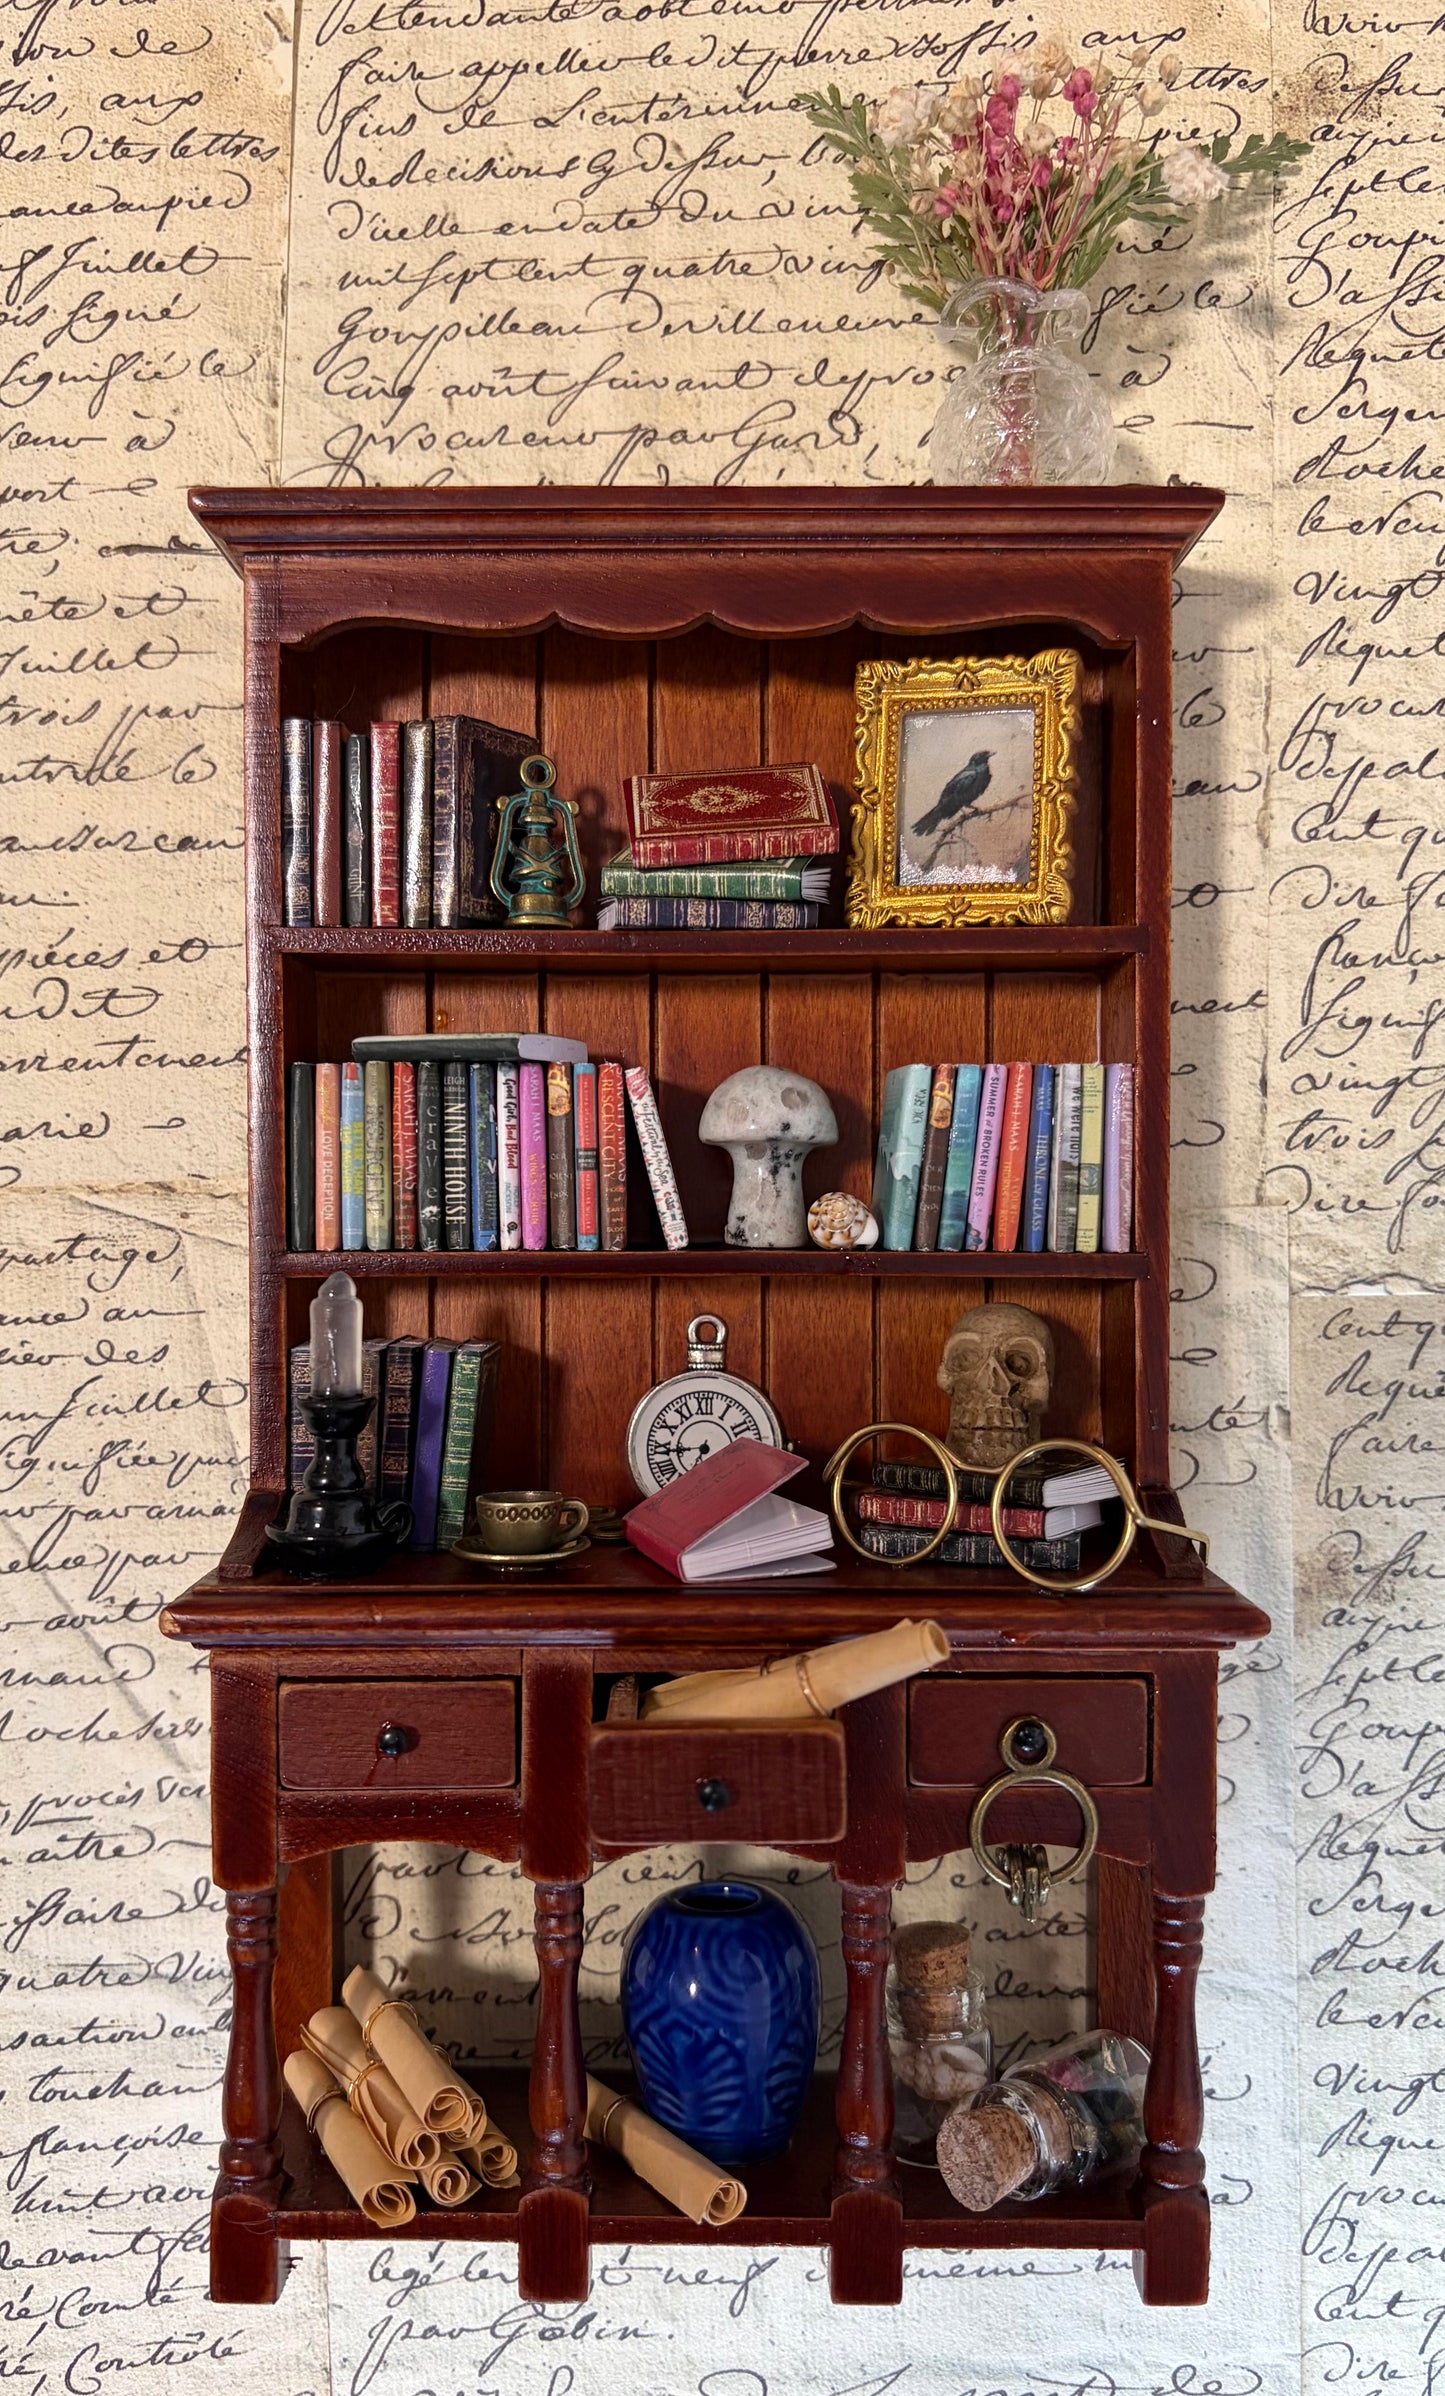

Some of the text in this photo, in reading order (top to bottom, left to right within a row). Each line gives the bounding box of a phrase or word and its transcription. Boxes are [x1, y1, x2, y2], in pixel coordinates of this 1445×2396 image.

[444, 1076, 465, 1085] LEIGH
[503, 1078, 517, 1100] Good
[403, 1074, 417, 1127] SARAH
[985, 1076, 1000, 1117] SUMMER
[506, 1124, 518, 1141] Bad
[532, 1112, 542, 1142] MAAS
[1009, 1121, 1022, 1152] MAAS
[323, 1130, 334, 1157] LOVE
[507, 1143, 519, 1170] Blood
[979, 1129, 993, 1168] BROKEN
[404, 1144, 417, 1190] MAAS
[444, 1102, 467, 1225] NINTH HOUSE
[601, 1146, 616, 1181] CITY
[655, 1169, 670, 1187] Sea
[323, 1161, 334, 1221] DECEPTION
[975, 1168, 988, 1197] RULES
[1031, 1133, 1049, 1232] THRONE GLASS
[675, 1402, 694, 1426] XI
[694, 1397, 714, 1416] XII
[658, 1418, 678, 1437] X
